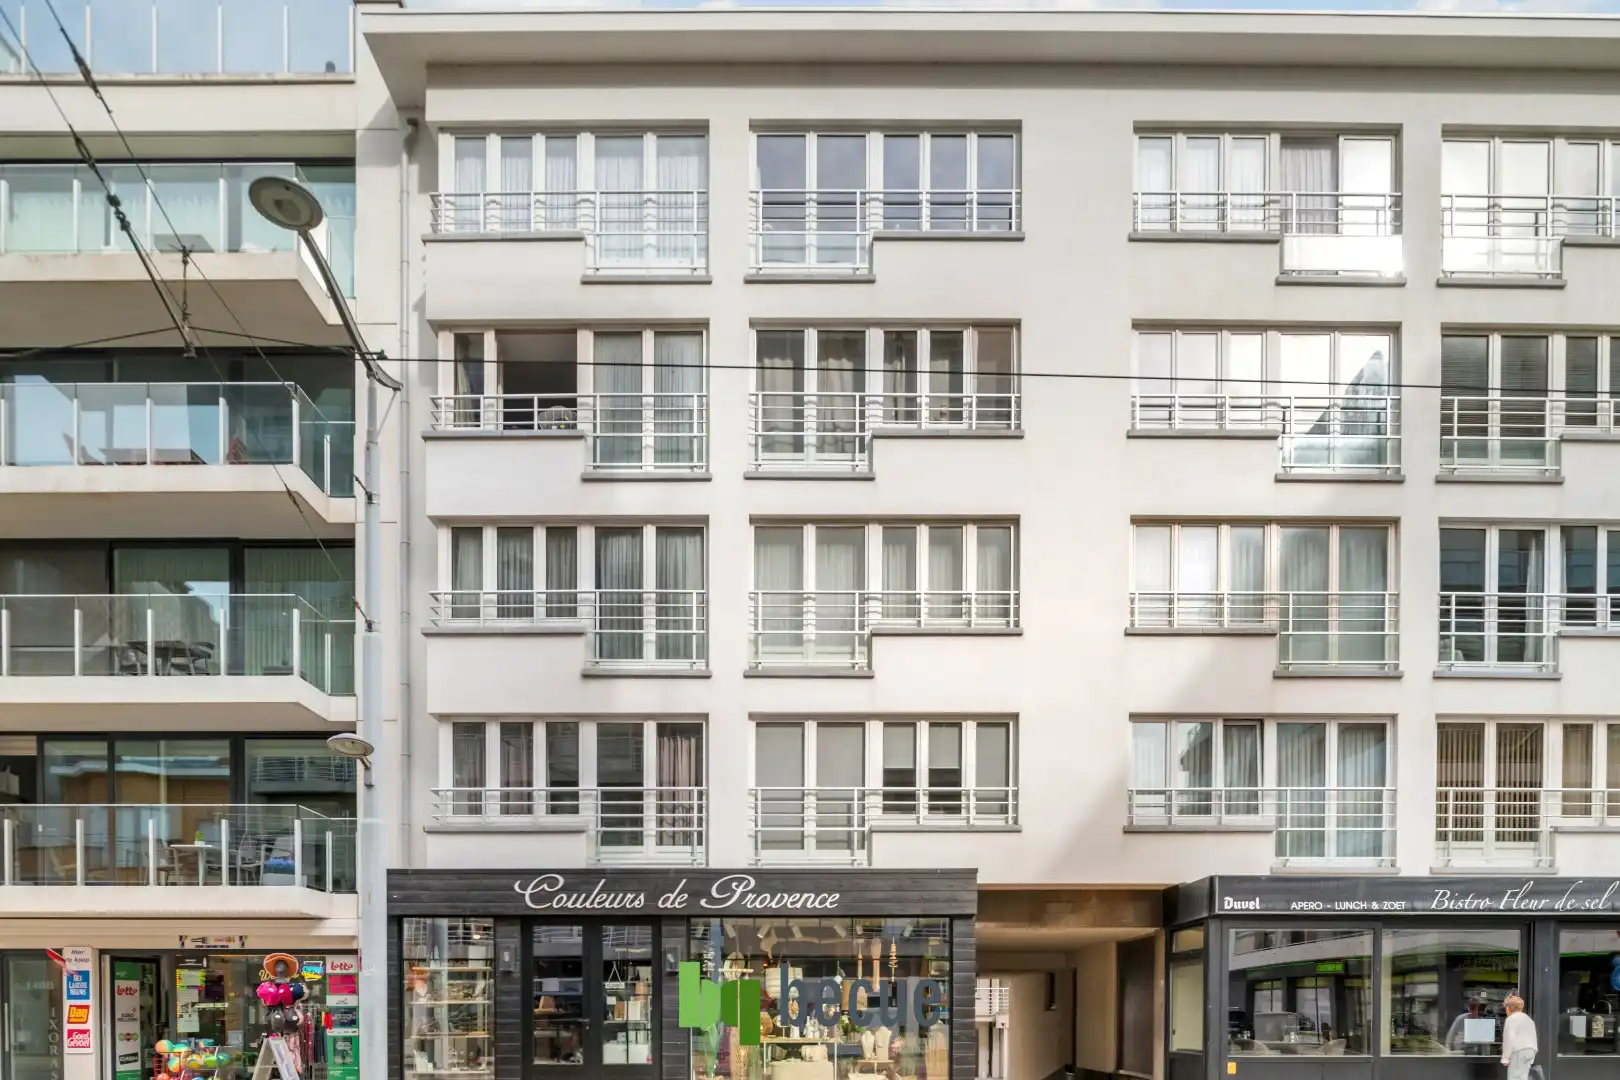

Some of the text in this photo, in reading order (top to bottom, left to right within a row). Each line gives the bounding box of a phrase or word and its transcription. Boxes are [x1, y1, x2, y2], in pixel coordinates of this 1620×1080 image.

[514, 874, 840, 909] Couleurs de Provence
[1430, 880, 1620, 912] Bistro Fleur de sel
[1223, 897, 1260, 910] Duvel
[1290, 902, 1323, 910] APERO
[1335, 902, 1367, 910] LUNCH
[1371, 902, 1379, 910] &
[1382, 902, 1406, 910] ZOET
